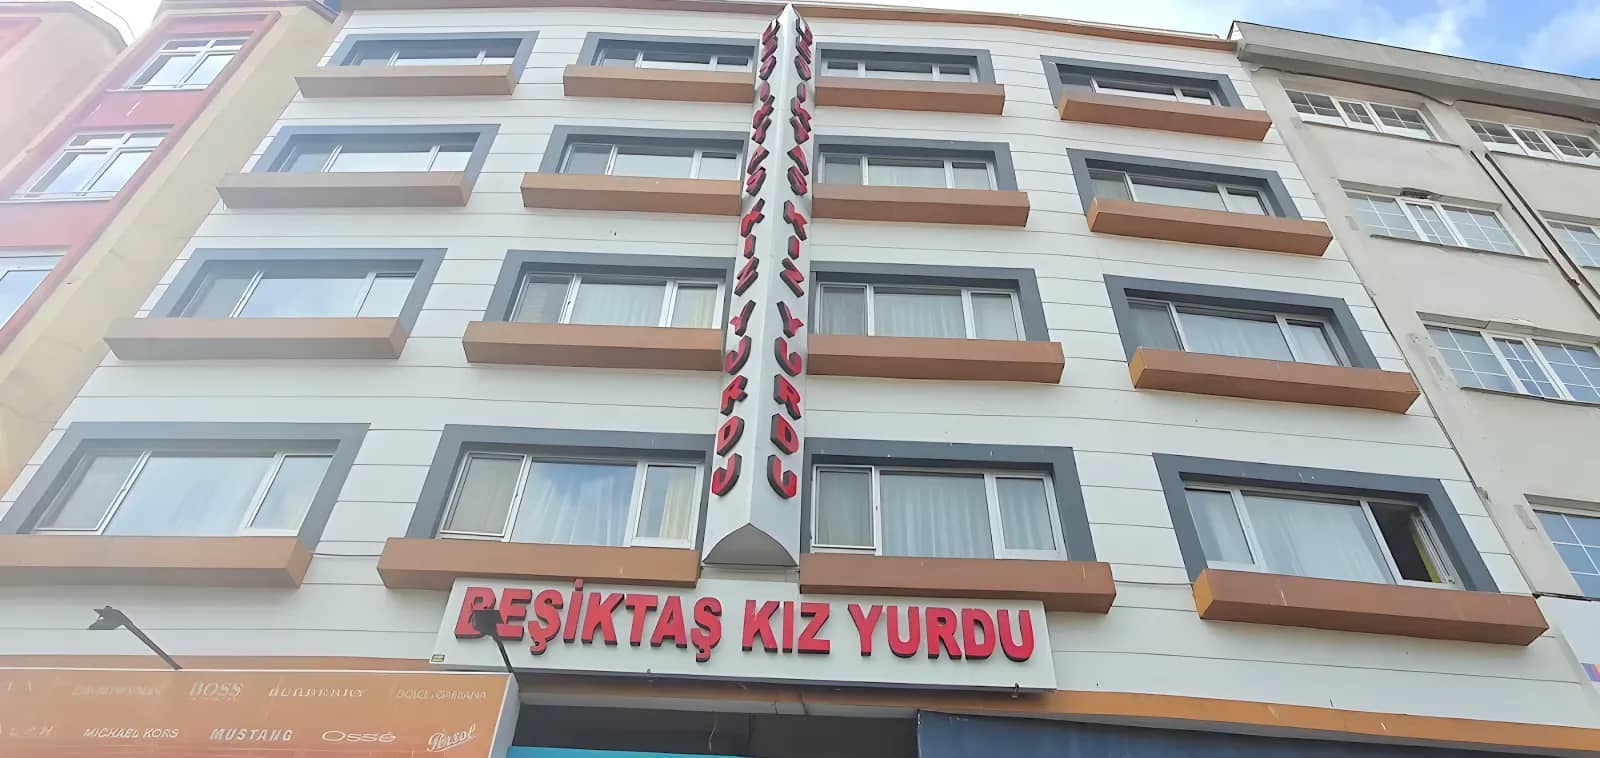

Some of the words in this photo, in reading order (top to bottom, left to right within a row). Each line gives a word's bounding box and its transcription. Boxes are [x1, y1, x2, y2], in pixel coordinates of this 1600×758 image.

[712, 300, 757, 497] YURDU
[767, 300, 805, 500] YURDU
[454, 578, 723, 663] BEŞİKTAŞ
[741, 599, 831, 656] KIZ
[847, 603, 1036, 663] YURDU
[190, 680, 243, 697] BOSS
[83, 727, 140, 739] MICHAEL
[142, 728, 180, 739] KORS
[209, 727, 295, 742] MUSTANG
